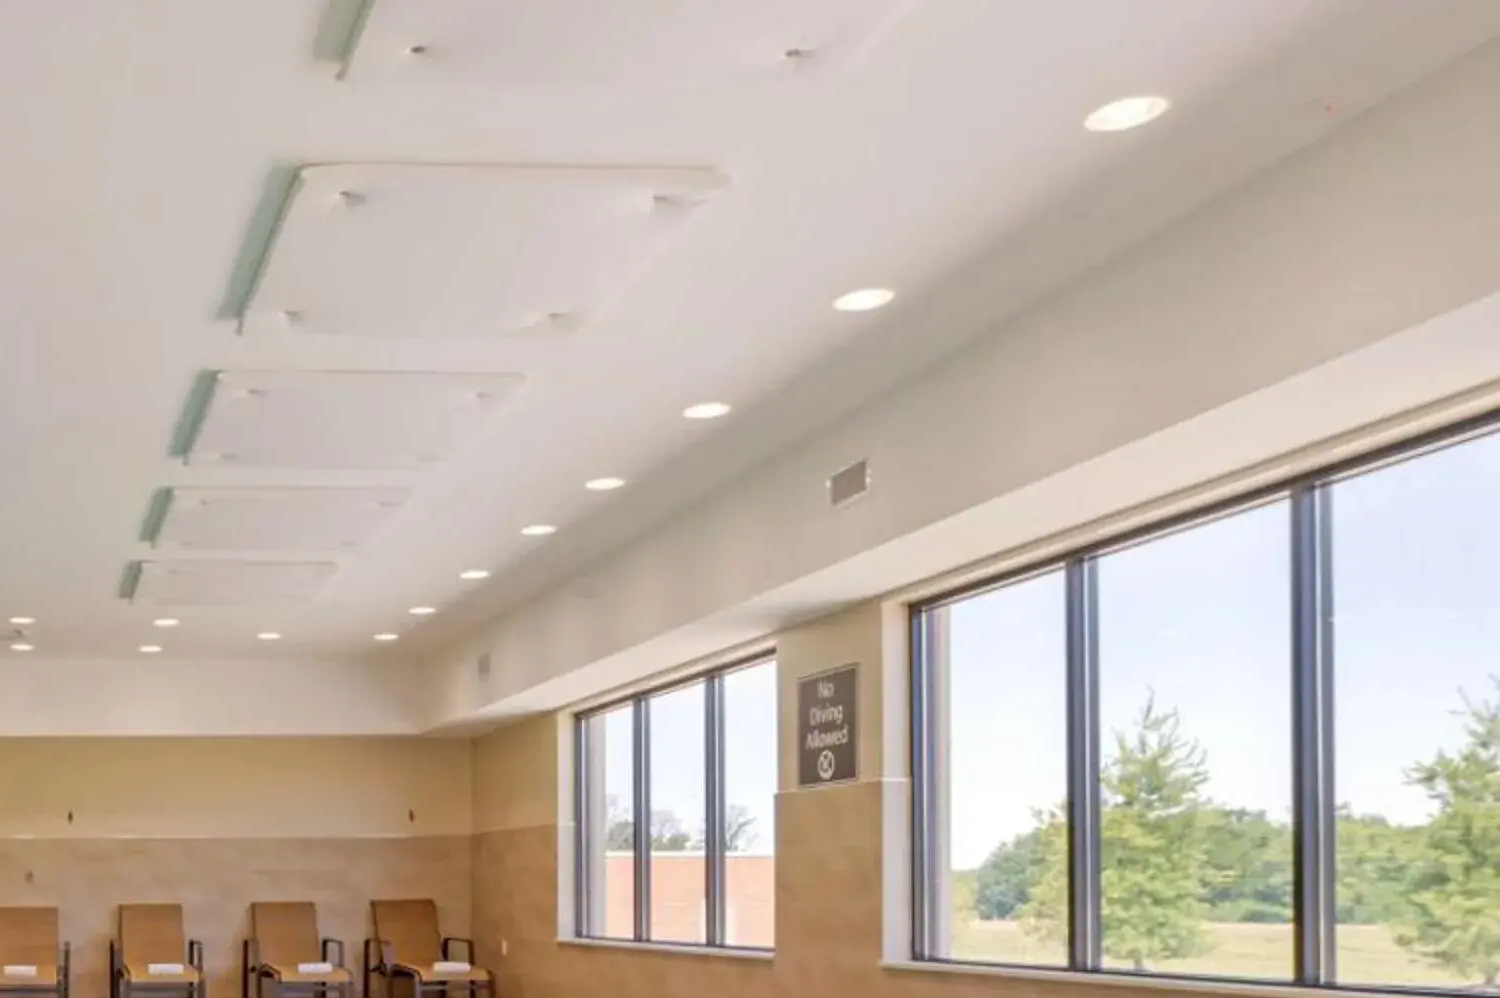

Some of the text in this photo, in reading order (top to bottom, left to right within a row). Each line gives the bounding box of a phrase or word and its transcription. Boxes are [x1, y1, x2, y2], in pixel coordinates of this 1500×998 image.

[817, 680, 835, 699] No
[809, 702, 843, 726] Diving
[805, 723, 849, 750] Allowed
